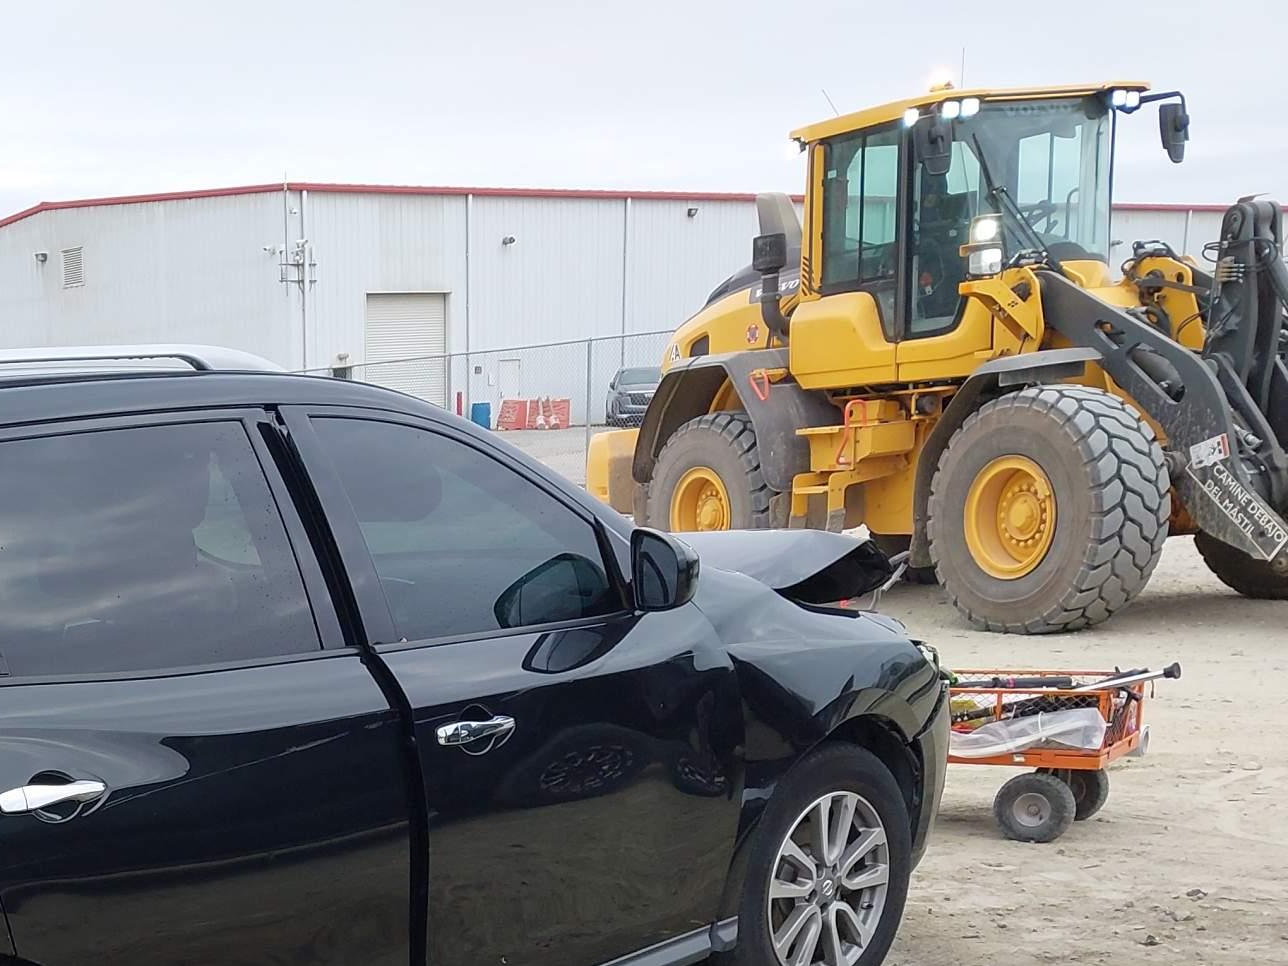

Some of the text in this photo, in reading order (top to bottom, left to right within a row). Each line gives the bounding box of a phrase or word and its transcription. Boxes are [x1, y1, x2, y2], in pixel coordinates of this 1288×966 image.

[755, 279, 800, 297] VVO
[1204, 480, 1222, 499] DEL
[1213, 465, 1284, 542] CAMINE DEBAJO
